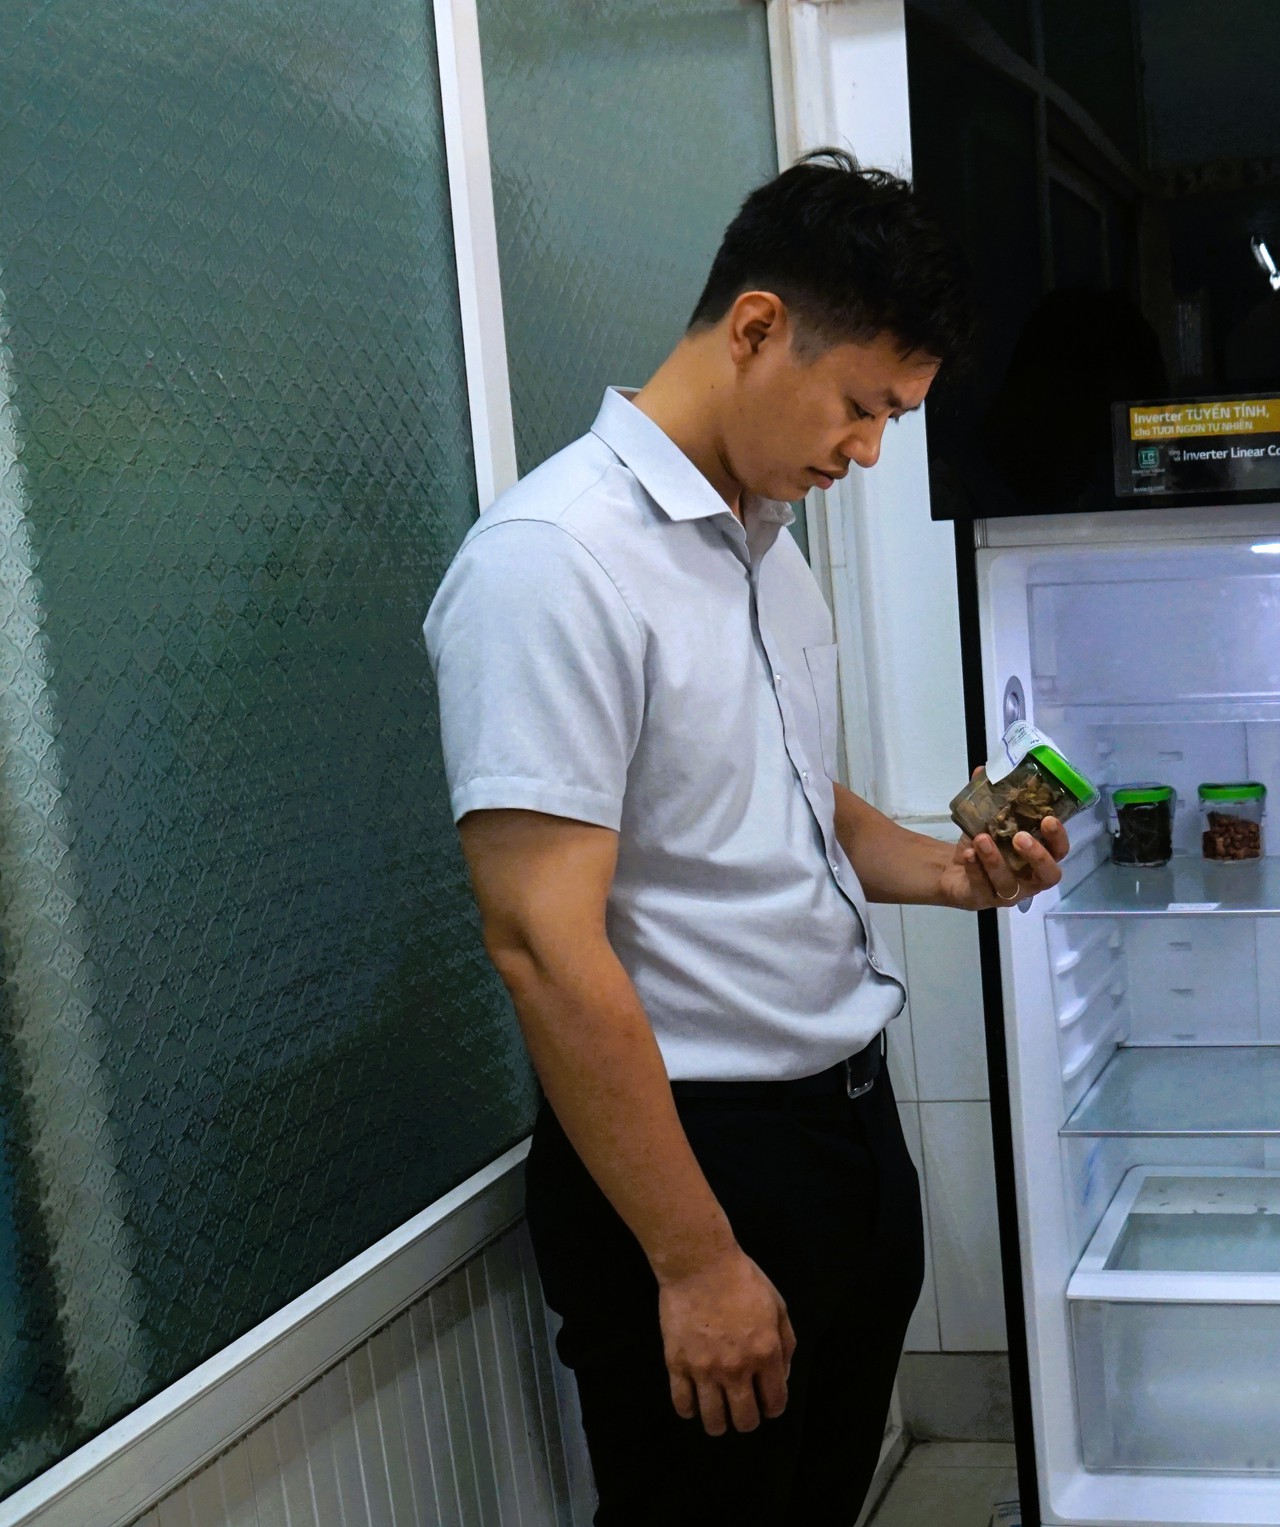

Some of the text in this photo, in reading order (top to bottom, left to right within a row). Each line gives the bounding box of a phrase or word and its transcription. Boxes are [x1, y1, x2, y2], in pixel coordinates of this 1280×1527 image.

[1134, 412, 1182, 424] Inverter
[1235, 404, 1270, 418] TÍNH,
[1134, 428, 1150, 437] cho
[1176, 424, 1206, 434] NGON
[1222, 420, 1253, 431] NHIÊN
[1183, 448, 1228, 461] Inverter
[1231, 447, 1265, 459] Linear
